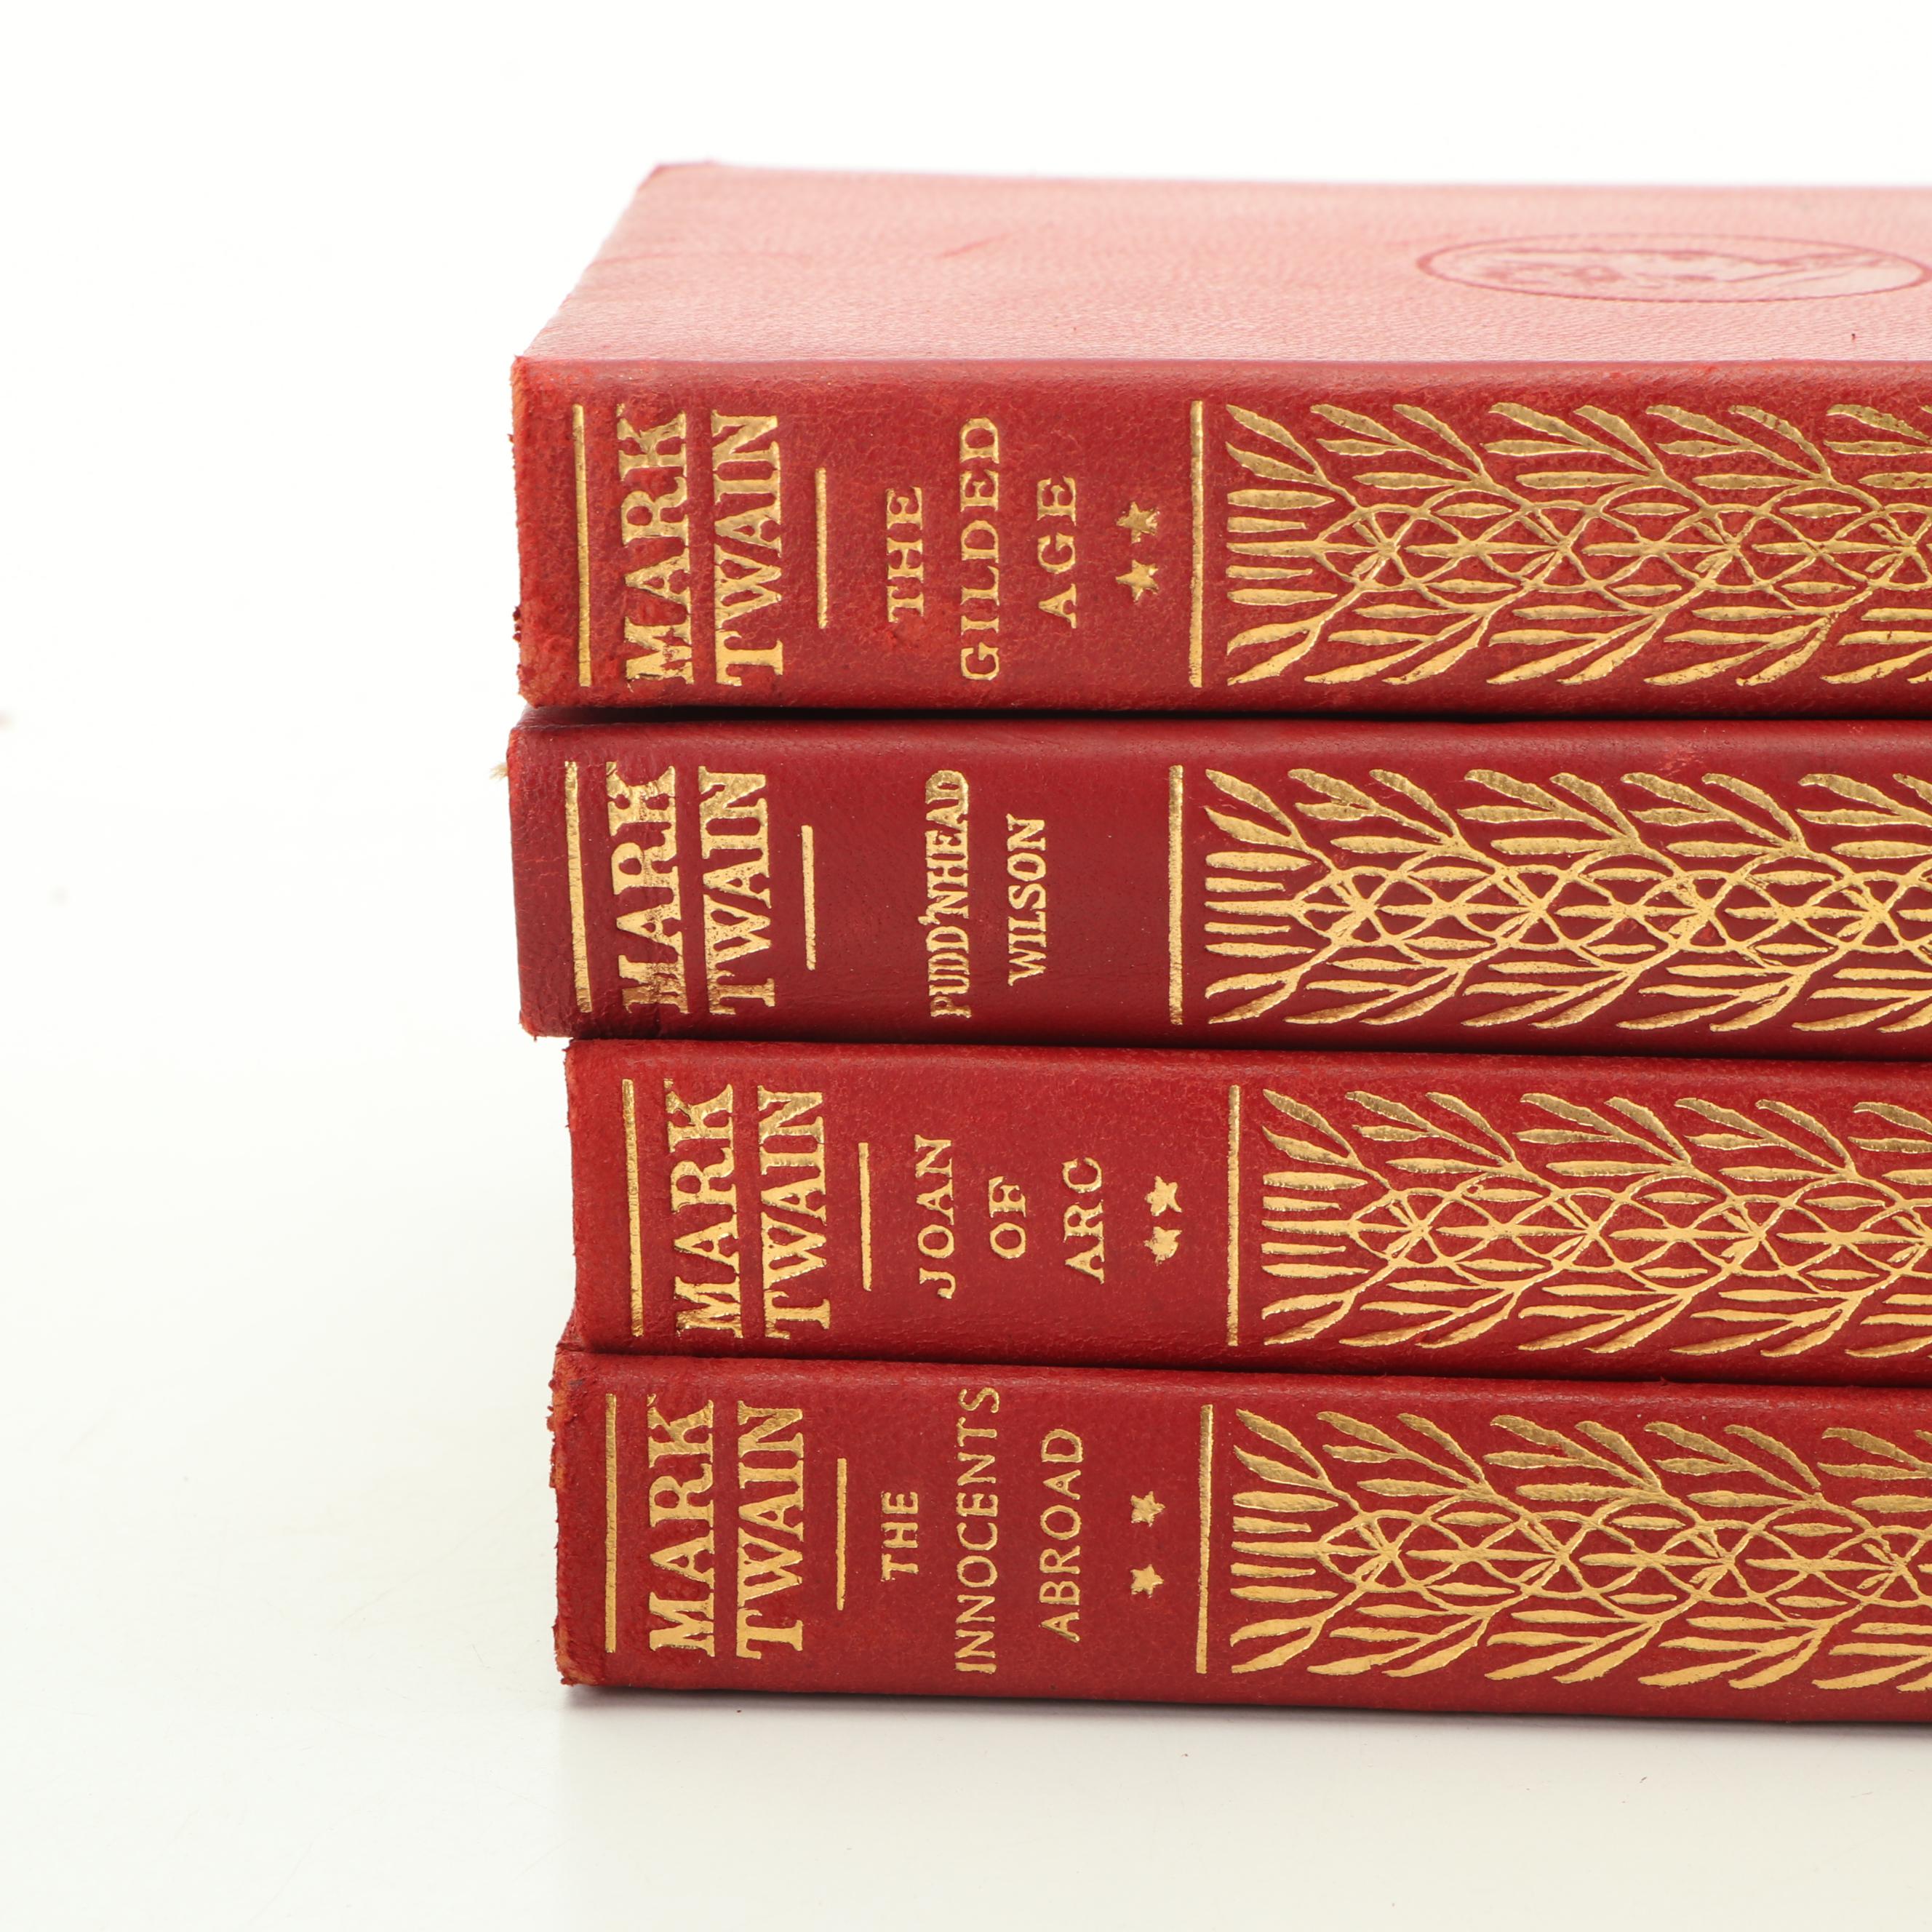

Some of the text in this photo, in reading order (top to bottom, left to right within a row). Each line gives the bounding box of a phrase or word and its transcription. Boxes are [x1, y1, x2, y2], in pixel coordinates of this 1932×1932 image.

[616, 402, 695, 684] MARK
[711, 410, 783, 686] TWAIN
[886, 487, 926, 623] THE
[959, 417, 1001, 680] GILDED
[1037, 476, 1078, 628] AGE
[606, 761, 689, 1013] MARK
[698, 766, 775, 1015] TWAIN
[1006, 813, 1047, 986] WILSON
[663, 1078, 743, 1338] MARK
[757, 1085, 831, 1339] TWAIN
[914, 1135, 956, 1299] JOAN
[988, 1176, 1026, 1259] OF
[1062, 1157, 1105, 1284] ARC
[647, 1394, 715, 1657] MARK
[736, 1400, 804, 1659] TWAIN
[881, 1492, 919, 1581] THE
[954, 1387, 999, 1674] INNOCENTS
[1039, 1429, 1084, 1642] ABROAD
